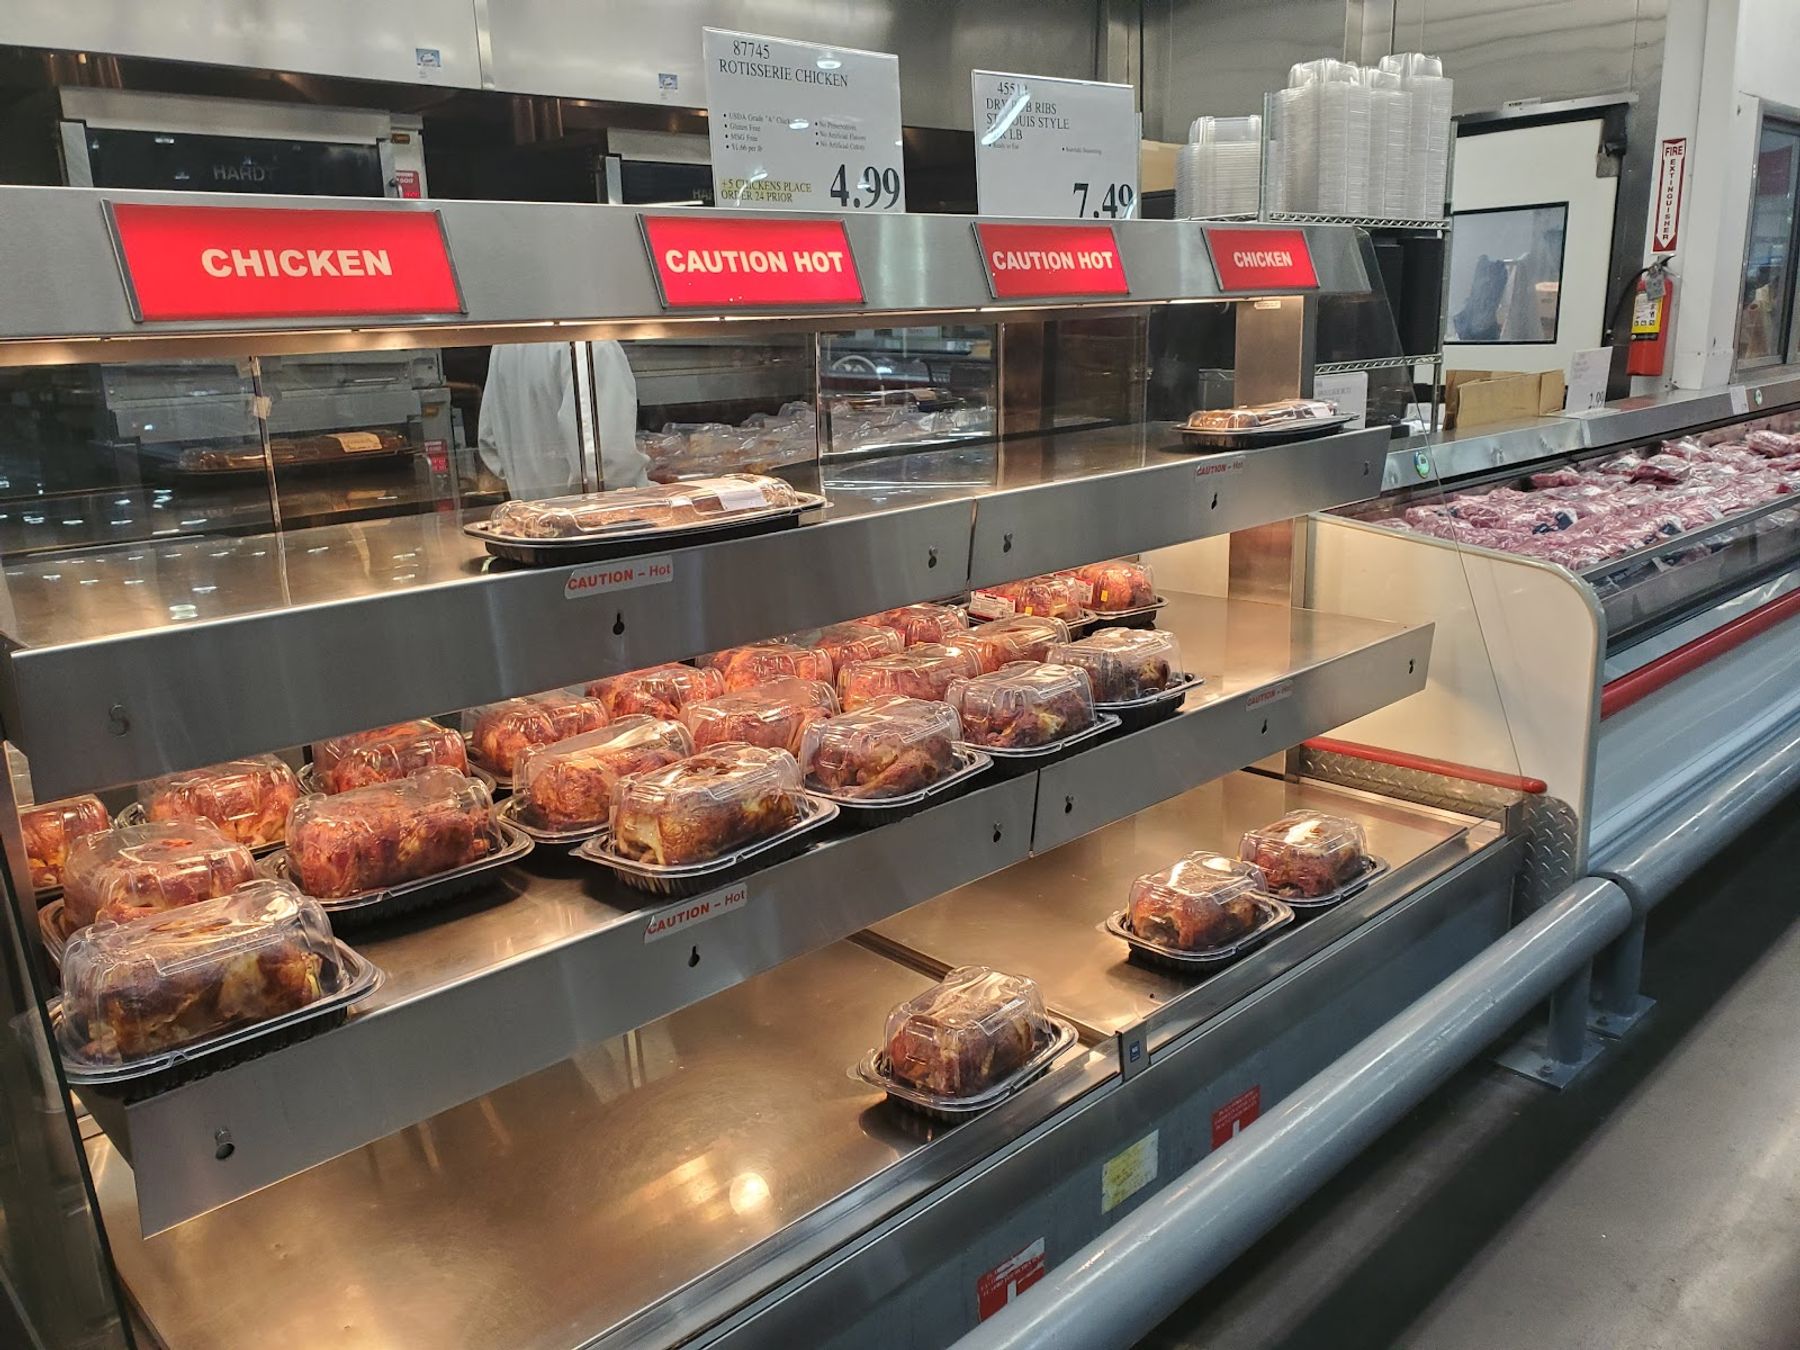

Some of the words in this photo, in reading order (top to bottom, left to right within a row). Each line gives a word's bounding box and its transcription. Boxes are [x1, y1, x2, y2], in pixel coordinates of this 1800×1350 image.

[733, 39, 770, 59] 87745
[719, 59, 792, 81] ROTISSERIE
[795, 69, 848, 87] CHICKEN
[1011, 101, 1032, 113] RB
[1035, 102, 1057, 114] RIBS
[1006, 115, 1036, 127] OUIS
[1038, 117, 1070, 130] STYLE
[1010, 129, 1023, 140] LB
[1665, 146, 1683, 156] FIRE
[784, 182, 812, 193] PLACE
[830, 163, 901, 210] 4.99
[767, 193, 793, 203] PRIOR
[1073, 183, 1134, 219] 7.49
[1662, 158, 1676, 240] EXTINGUISHER
[201, 248, 393, 277] CHICKEN
[665, 249, 788, 273] CAUTION
[793, 251, 843, 273] HOT
[992, 251, 1074, 271] CAUTION
[1079, 251, 1113, 270] HOT
[1233, 251, 1293, 268] CHICKEN
[1195, 463, 1227, 477] CAUTION
[568, 568, 634, 590] CAUTION
[649, 564, 671, 577] Hot
[647, 902, 710, 934] CAUTION
[724, 890, 745, 906] Hot
